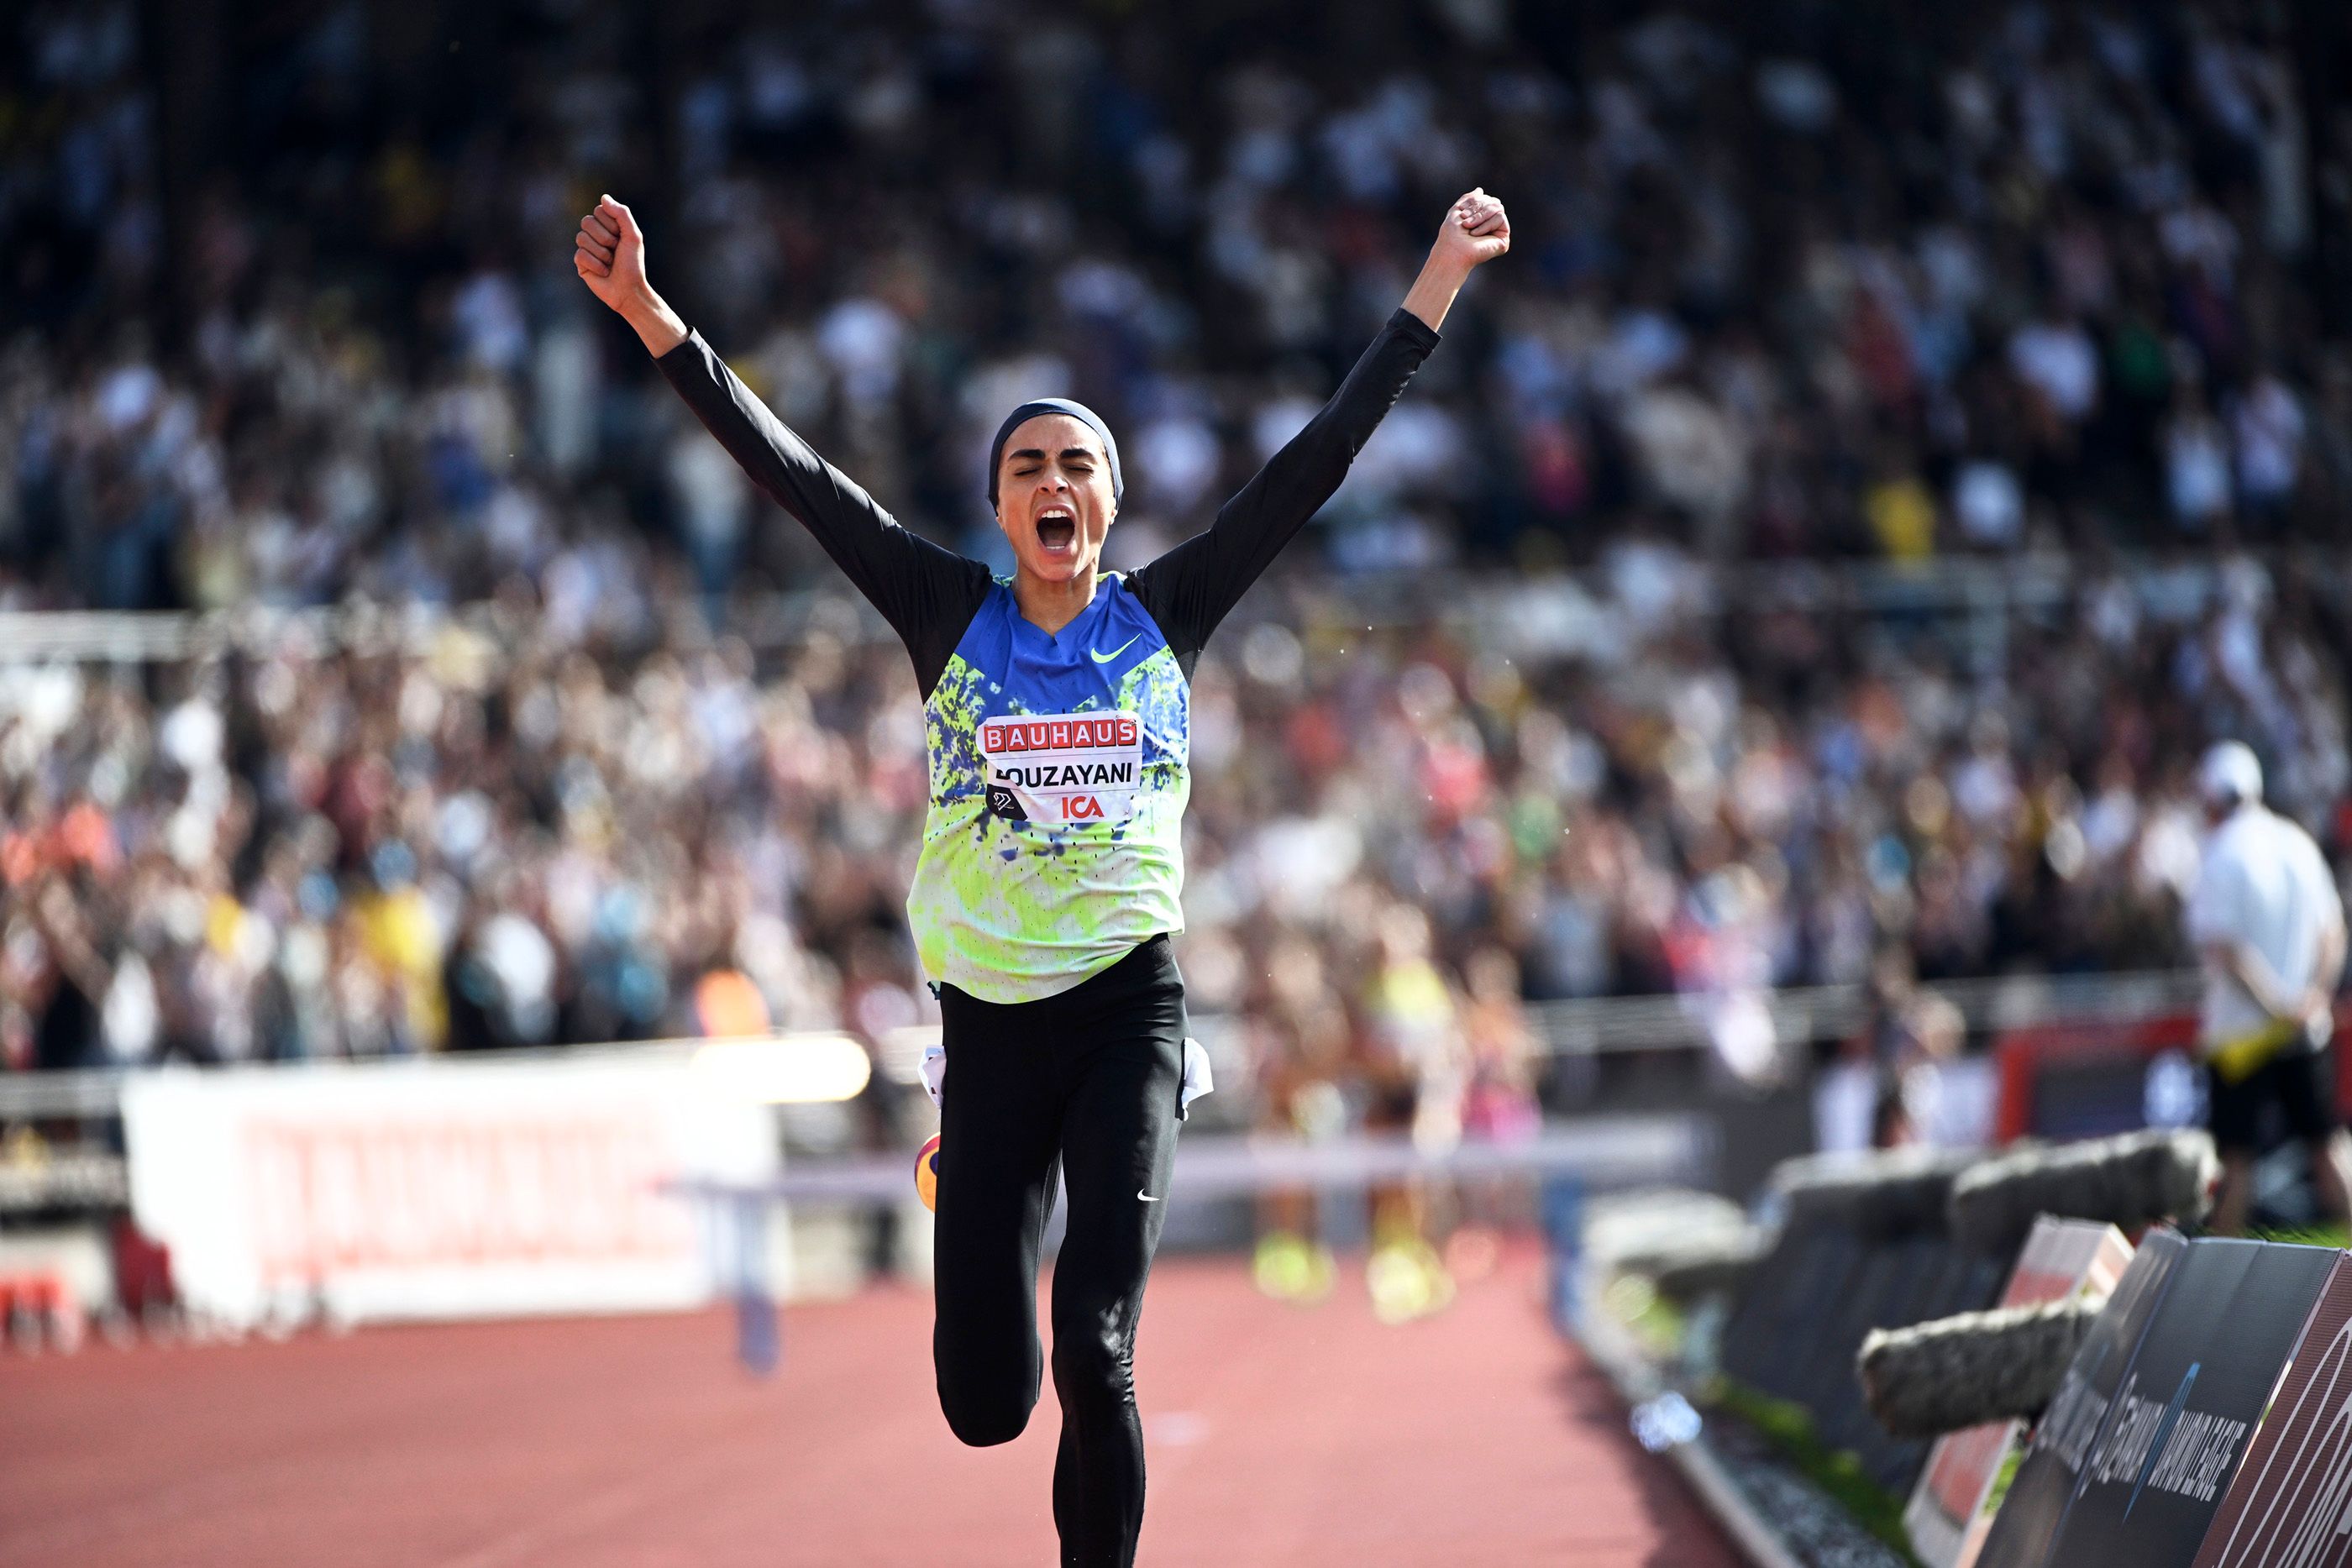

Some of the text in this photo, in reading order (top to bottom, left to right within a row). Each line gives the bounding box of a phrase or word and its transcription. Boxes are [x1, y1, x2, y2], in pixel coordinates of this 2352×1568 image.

[986, 721, 1136, 749] BAUHAUS
[1062, 795, 1105, 820] ICA
[2180, 1416, 2247, 1502] LEAGUE
